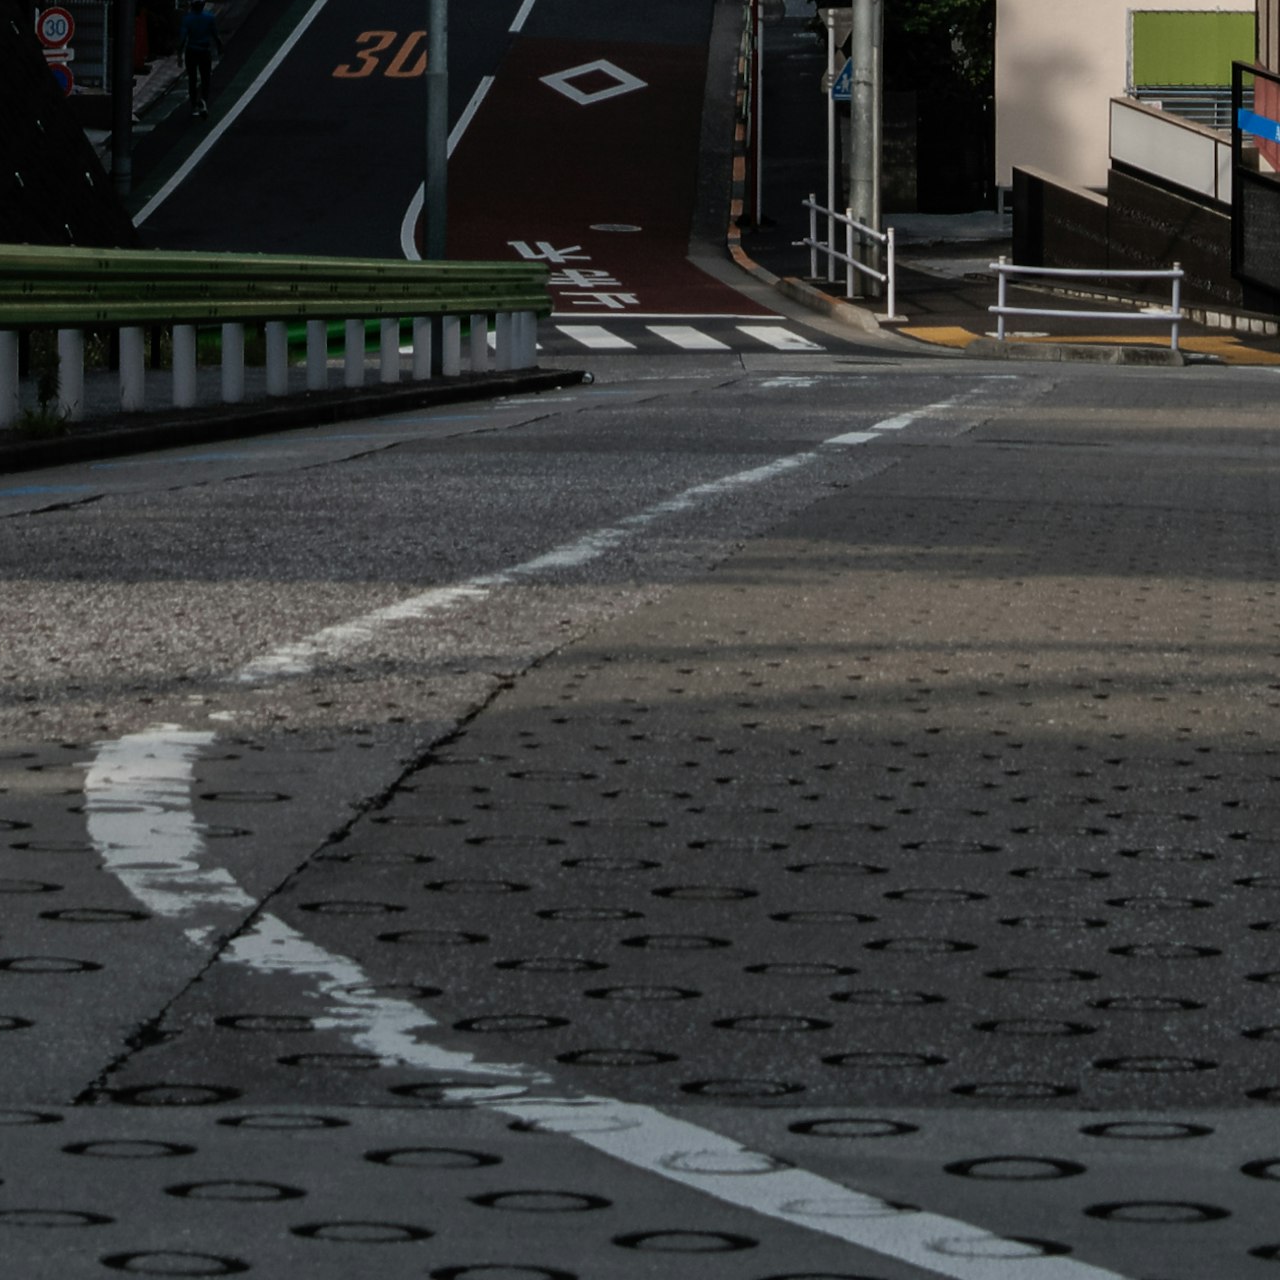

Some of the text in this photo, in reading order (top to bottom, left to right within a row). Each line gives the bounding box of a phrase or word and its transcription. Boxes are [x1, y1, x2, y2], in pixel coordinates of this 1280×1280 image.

[44, 18, 66, 37] 30
[331, 30, 428, 79] 30
[506, 240, 641, 309] 止まれ
